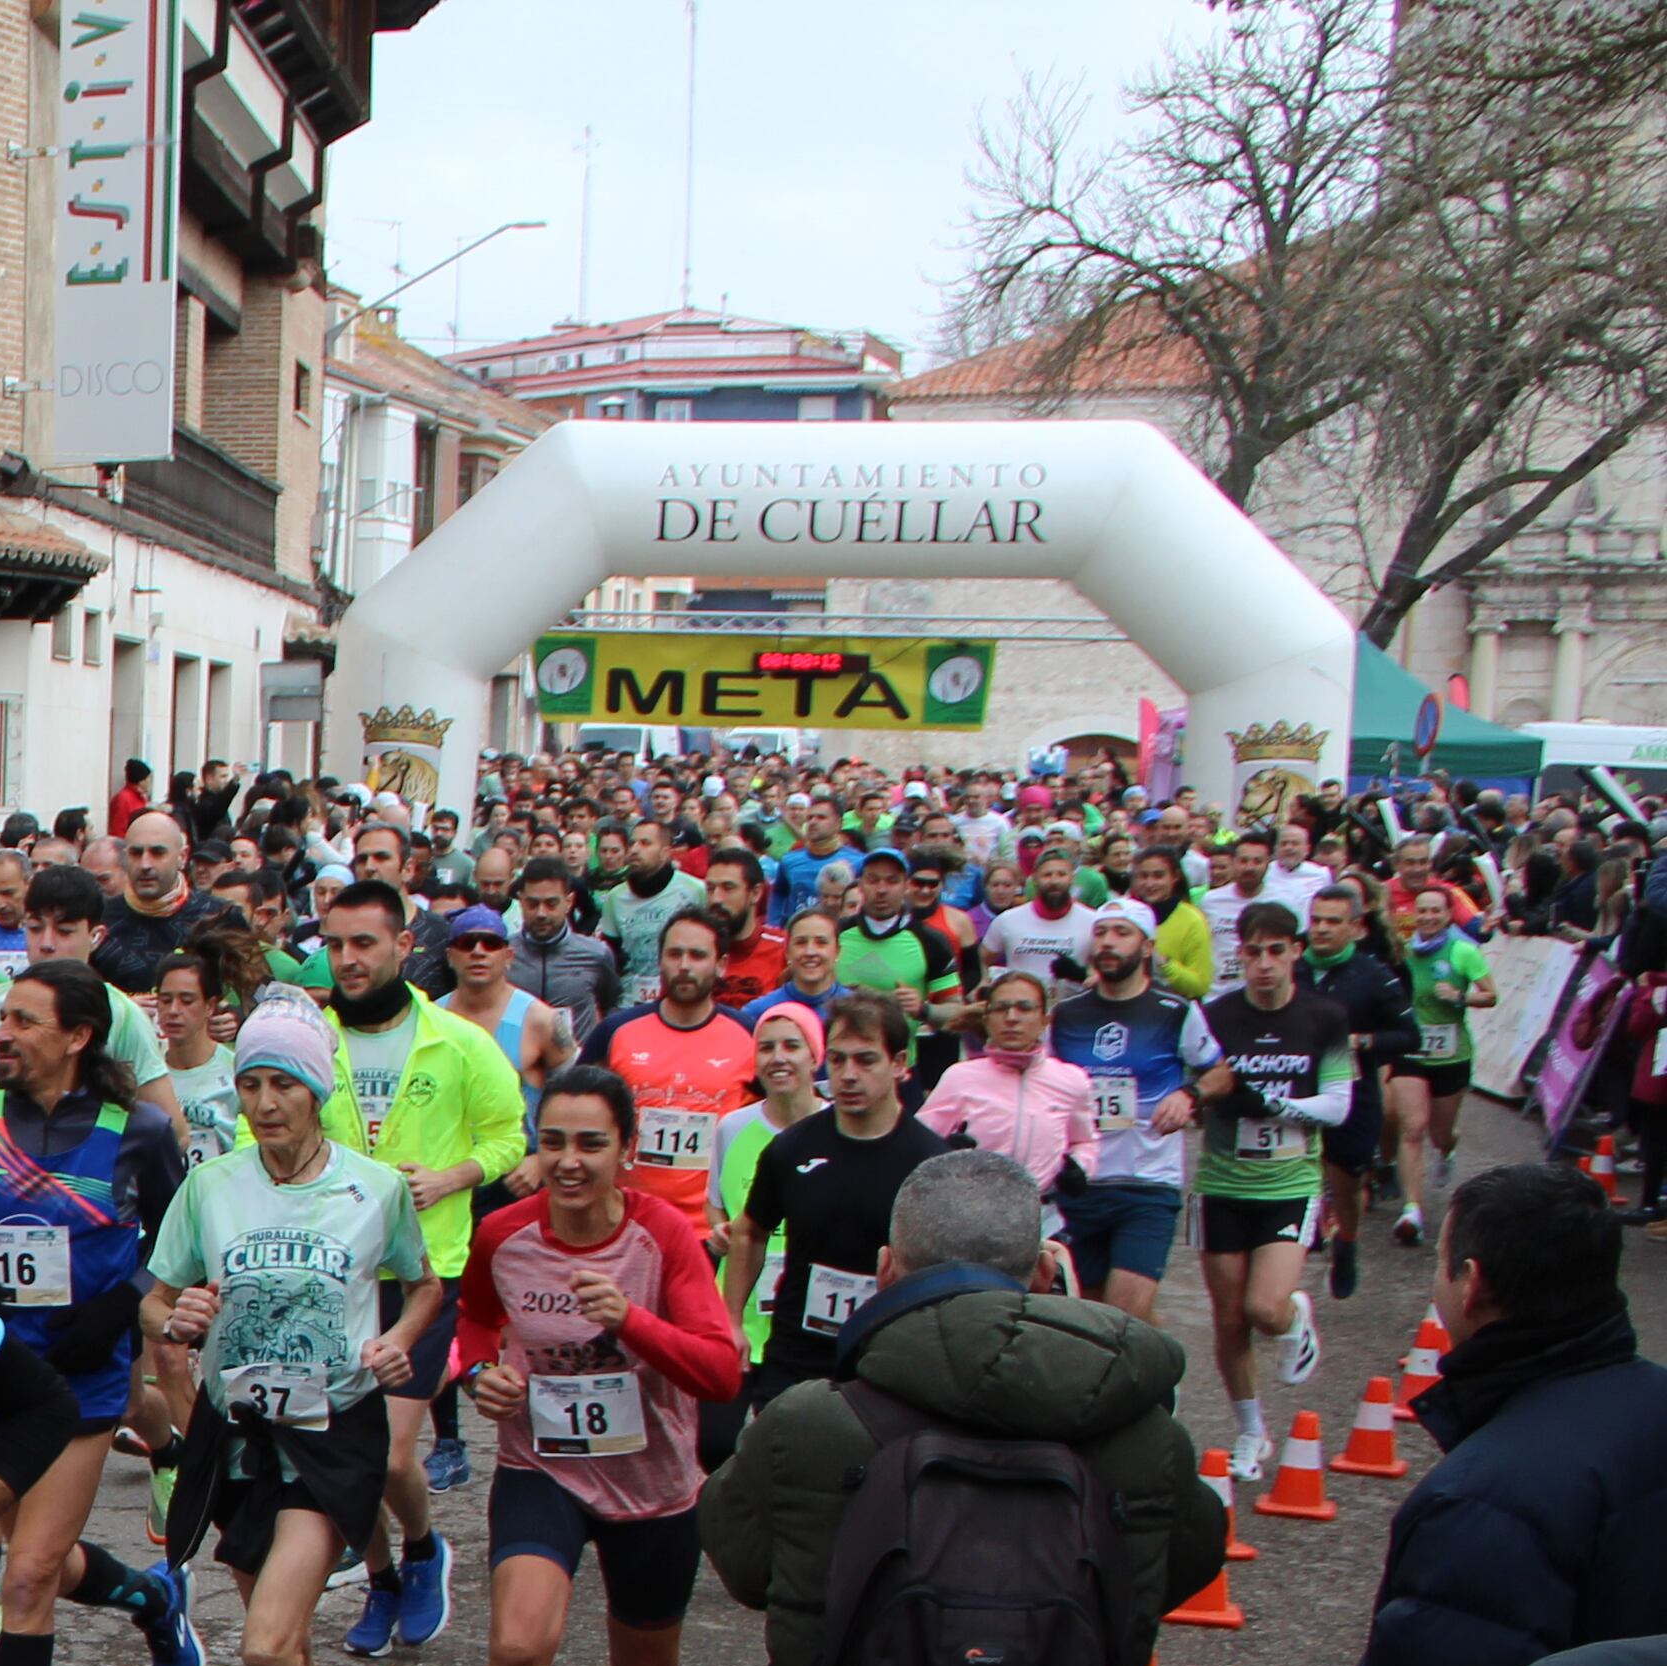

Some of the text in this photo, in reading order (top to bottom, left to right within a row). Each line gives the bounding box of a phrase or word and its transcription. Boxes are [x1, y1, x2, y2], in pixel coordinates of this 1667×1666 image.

[60, 360, 164, 398] DISCO
[657, 462, 1047, 489] AYUNTAMIENTO
[653, 491, 1049, 545] DE CUÉLLAR
[603, 667, 910, 720] META
[653, 1128, 700, 1154] 114
[1257, 1126, 1283, 1147] 51
[225, 1240, 350, 1278] CUELLAR
[249, 1383, 291, 1417] 37
[564, 1402, 608, 1435] 18
